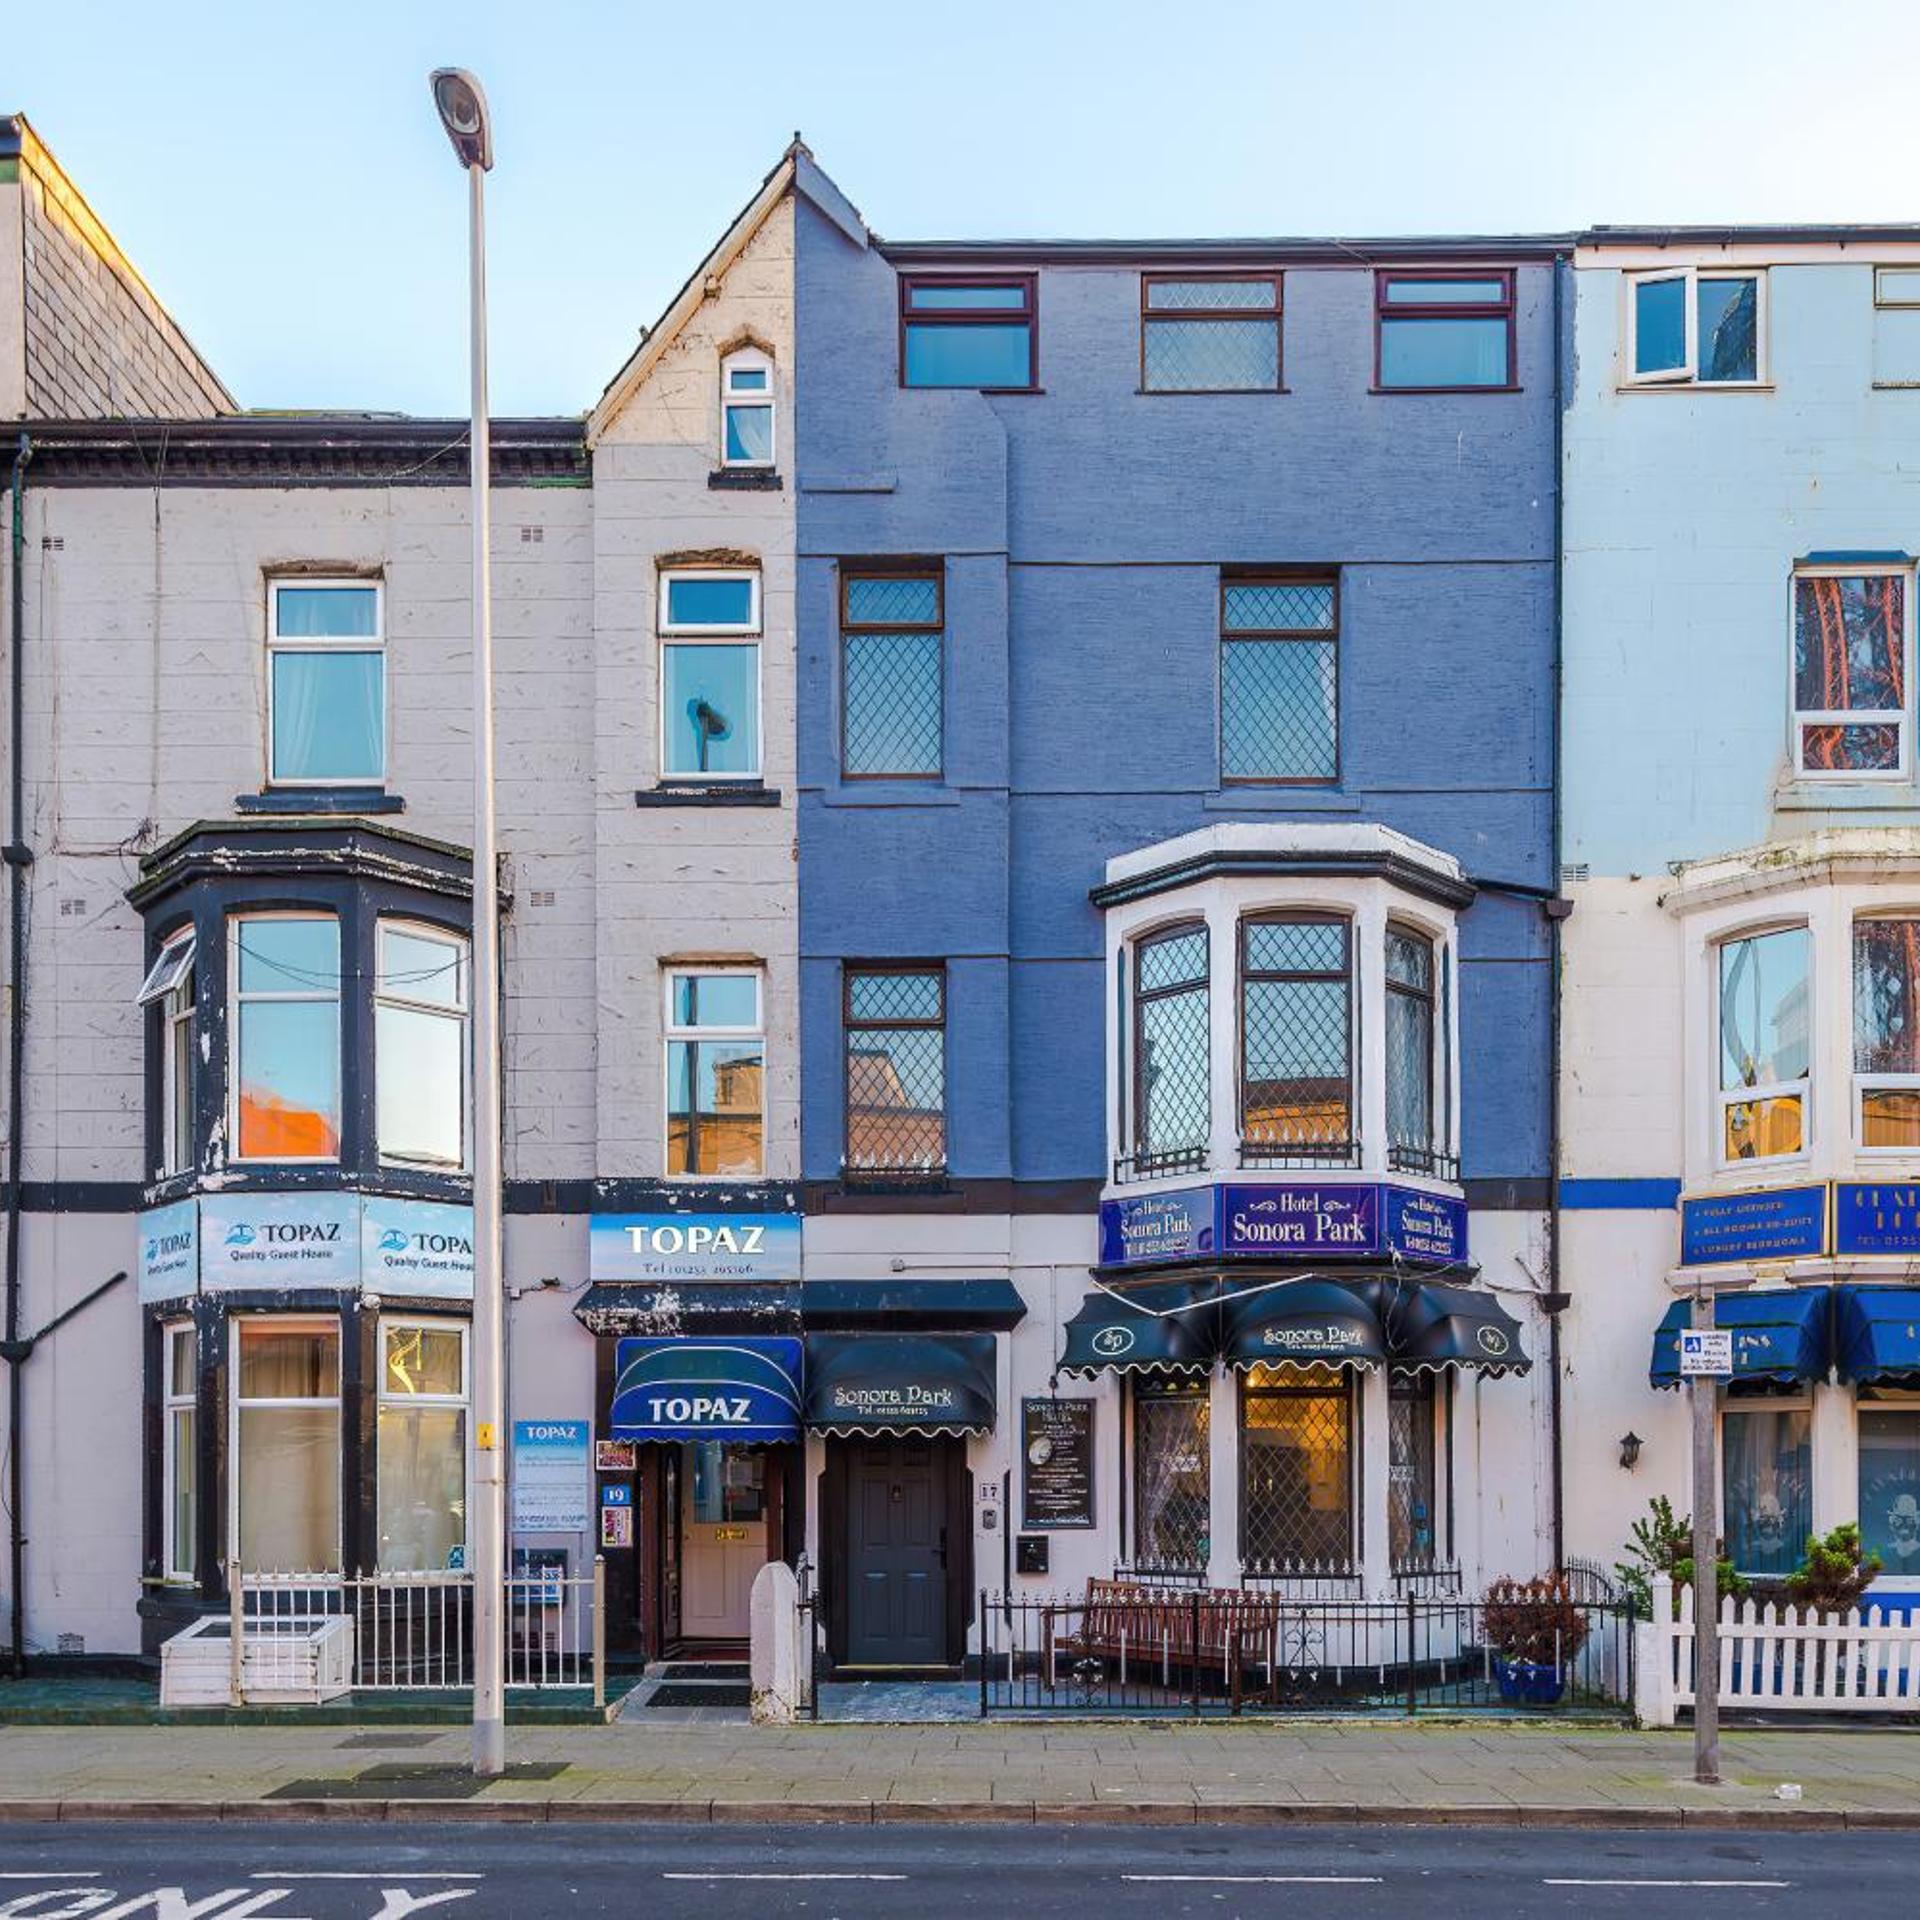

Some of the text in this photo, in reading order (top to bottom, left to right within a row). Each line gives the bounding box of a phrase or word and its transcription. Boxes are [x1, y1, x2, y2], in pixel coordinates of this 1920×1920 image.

[1281, 1193, 1319, 1213] Hotel
[260, 1223, 341, 1242] TOPAZ
[1233, 1213, 1366, 1242] Sonora Park
[160, 1231, 192, 1255] TOPAZ
[411, 1233, 473, 1254] TOPA
[624, 1226, 765, 1255] TOPAZ
[230, 1250, 266, 1262] Quality
[1263, 1328, 1324, 1346] Sonora
[1327, 1326, 1364, 1347] Park
[835, 1385, 953, 1408] Sonora Park
[648, 1398, 752, 1422] TOPAZ
[527, 1426, 577, 1440] TOPAZ
[609, 1487, 625, 1502] 19
[981, 1486, 998, 1498] 17
